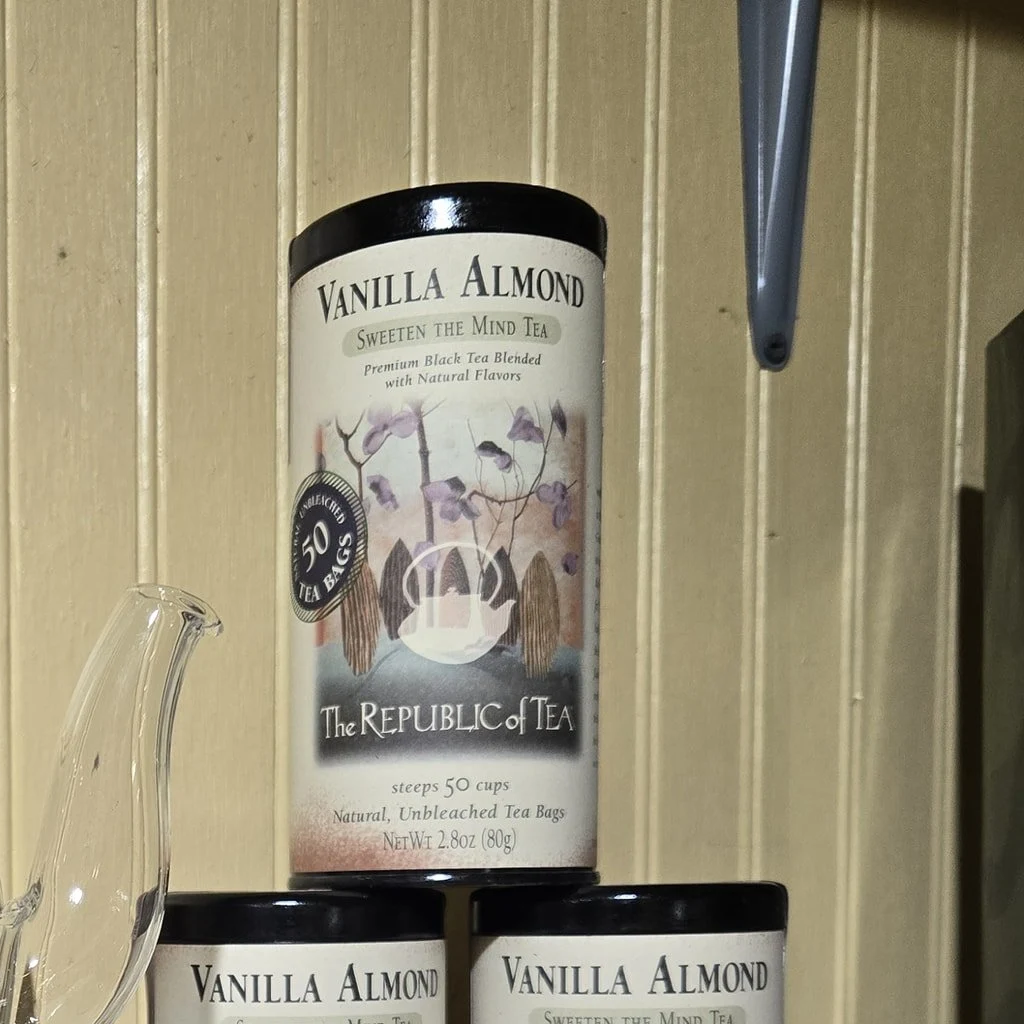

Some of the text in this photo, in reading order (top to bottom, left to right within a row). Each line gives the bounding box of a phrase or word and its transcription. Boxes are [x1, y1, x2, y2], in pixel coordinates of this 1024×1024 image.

[317, 254, 584, 324] VANILLA ALMOND
[357, 315, 548, 350] SWEETEN THE MIND TEA
[364, 352, 541, 376] Premium Black Tea Blended
[385, 369, 521, 389] with Natural Flavors
[299, 494, 345, 525] UNBLEACHED
[302, 521, 328, 573] 50
[299, 532, 352, 602] TEA BAGS
[320, 695, 573, 738] The REPUBLIC of TEA
[392, 777, 509, 798] steeps 50 cups
[333, 803, 565, 824] Natural, Unbleached Tea Bags
[481, 827, 517, 854] (80g)
[190, 963, 438, 1003] VANILLA ALMOND
[502, 954, 768, 994] VANILLA ALMOND
